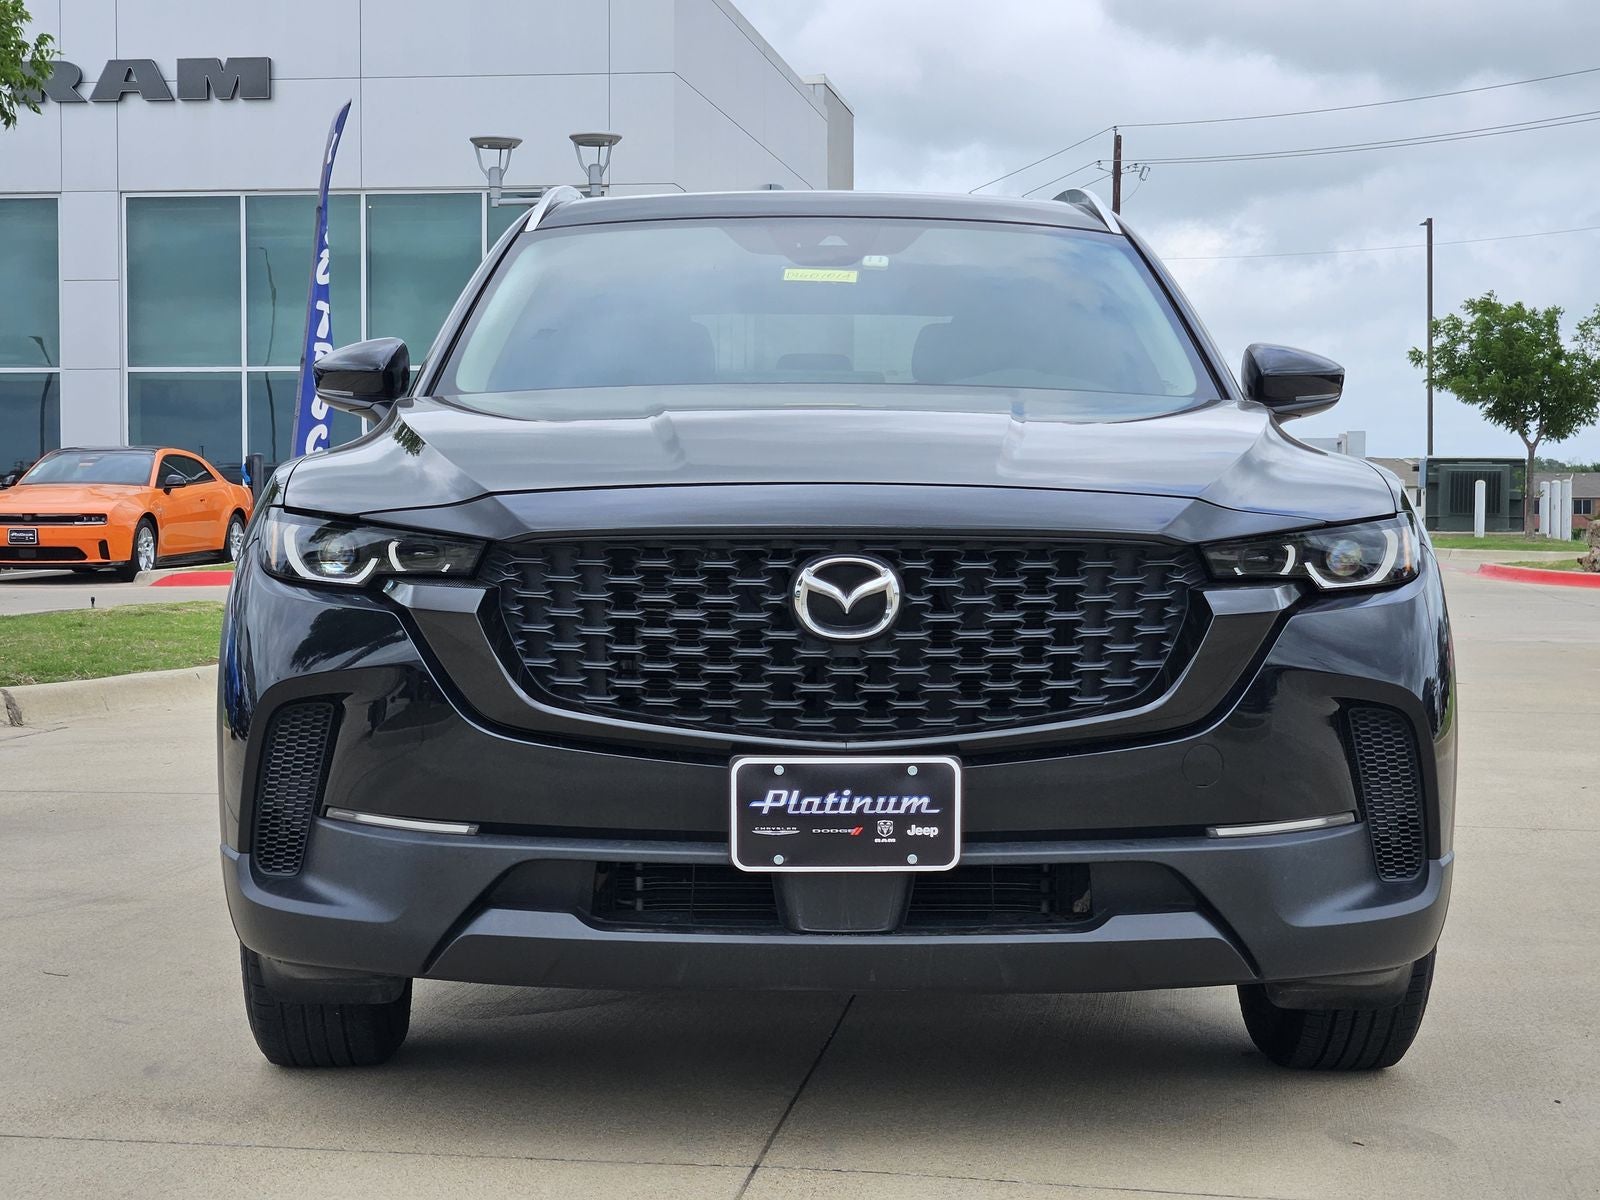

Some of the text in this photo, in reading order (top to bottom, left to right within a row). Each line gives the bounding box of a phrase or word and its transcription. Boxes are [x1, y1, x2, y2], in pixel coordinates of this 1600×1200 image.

[17, 57, 271, 103] RAM
[749, 789, 943, 815] Platinum
[906, 824, 939, 838] Jeep
